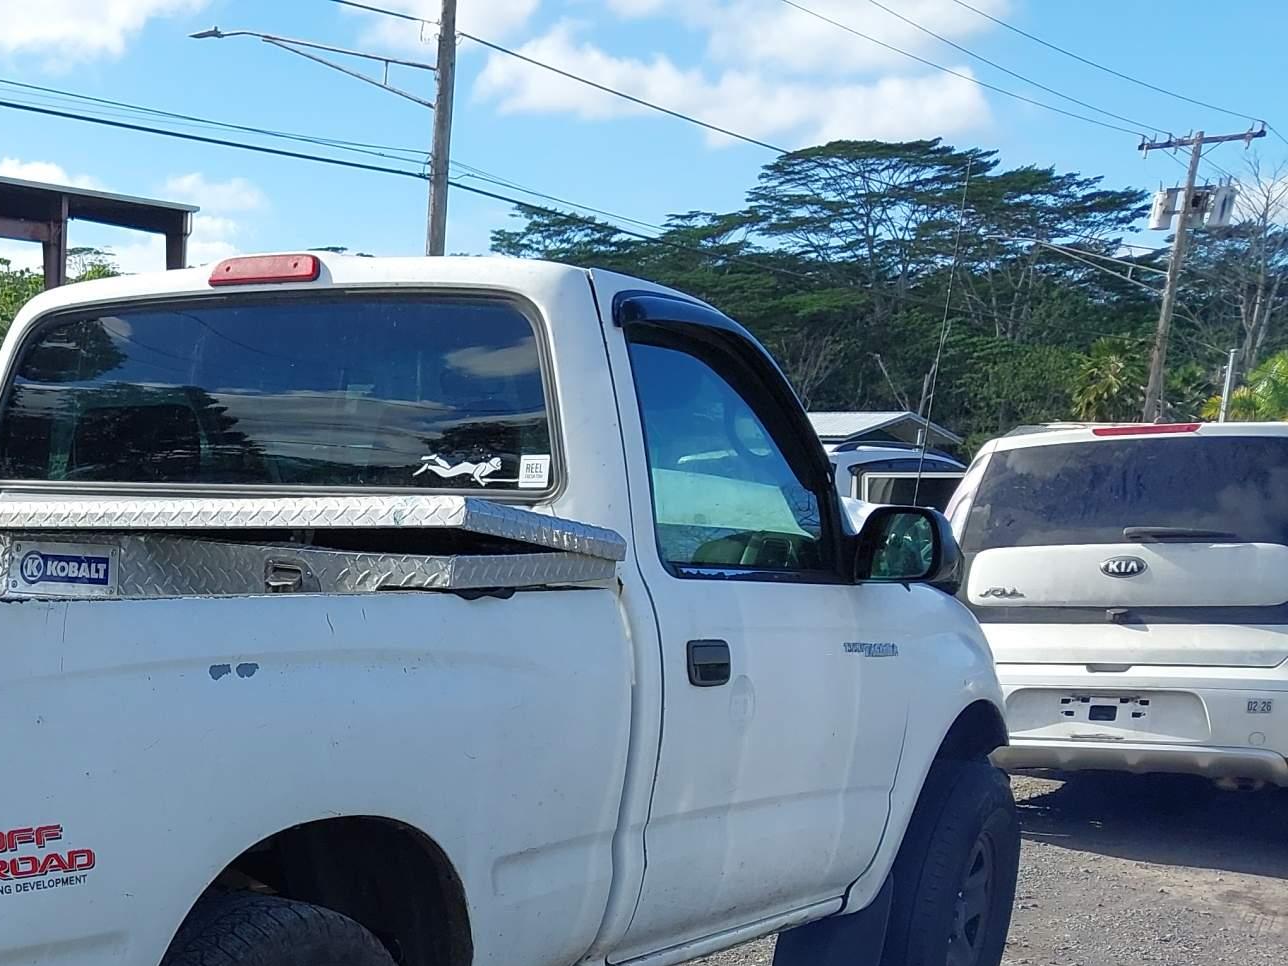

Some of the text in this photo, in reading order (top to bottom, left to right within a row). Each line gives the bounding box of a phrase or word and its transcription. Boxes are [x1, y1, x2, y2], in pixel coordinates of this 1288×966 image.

[46, 560, 107, 579] KOBALT
[1108, 560, 1139, 573] KIA
[15, 874, 87, 893] DEVELOPMENT
